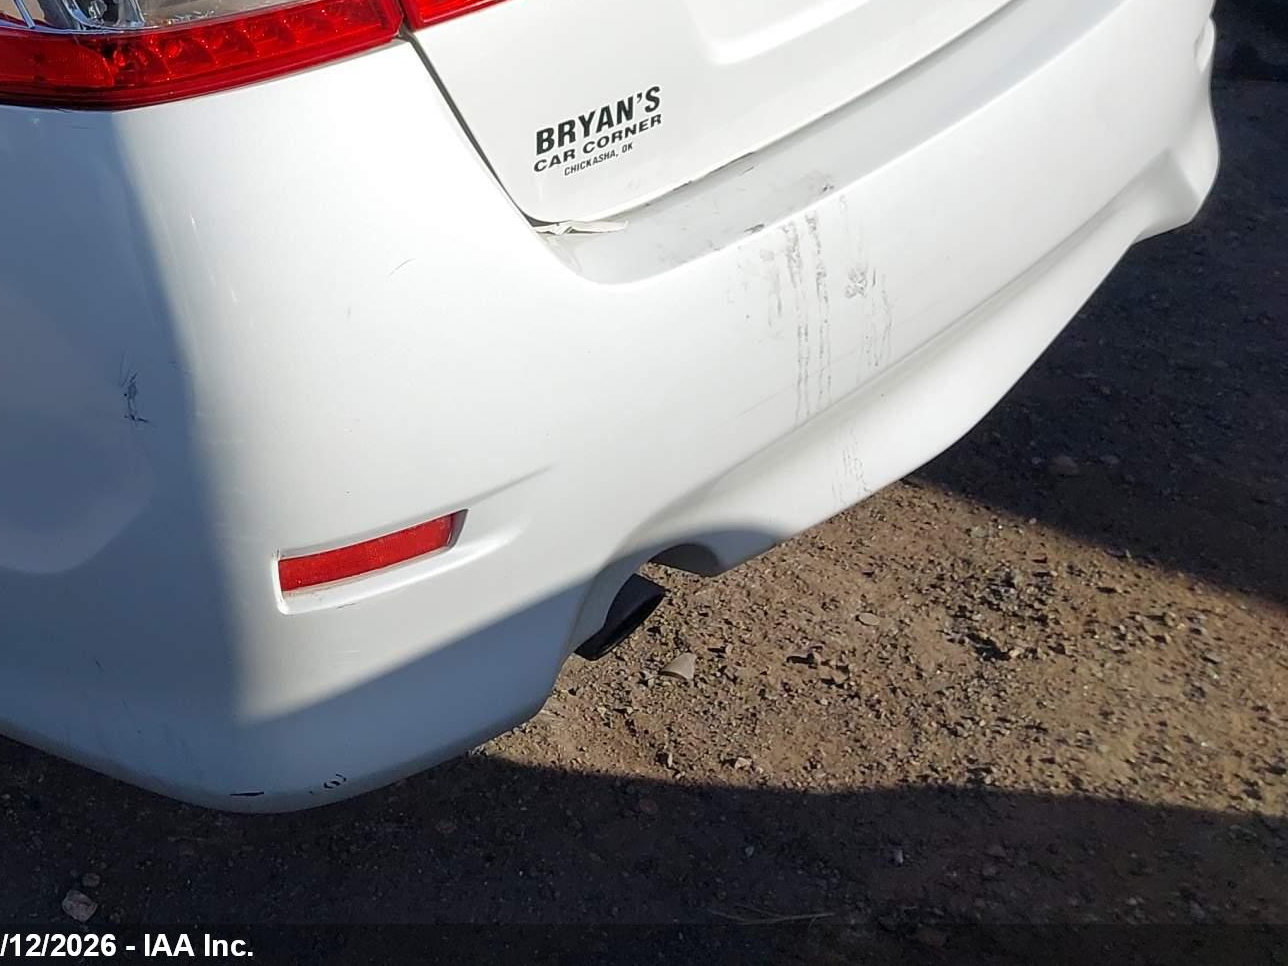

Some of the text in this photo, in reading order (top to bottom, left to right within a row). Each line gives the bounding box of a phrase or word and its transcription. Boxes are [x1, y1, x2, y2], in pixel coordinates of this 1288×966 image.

[533, 113, 662, 173] CAR CORNER
[536, 86, 661, 155] BRYAN'S
[564, 142, 633, 176] CHICKASHA, OK
